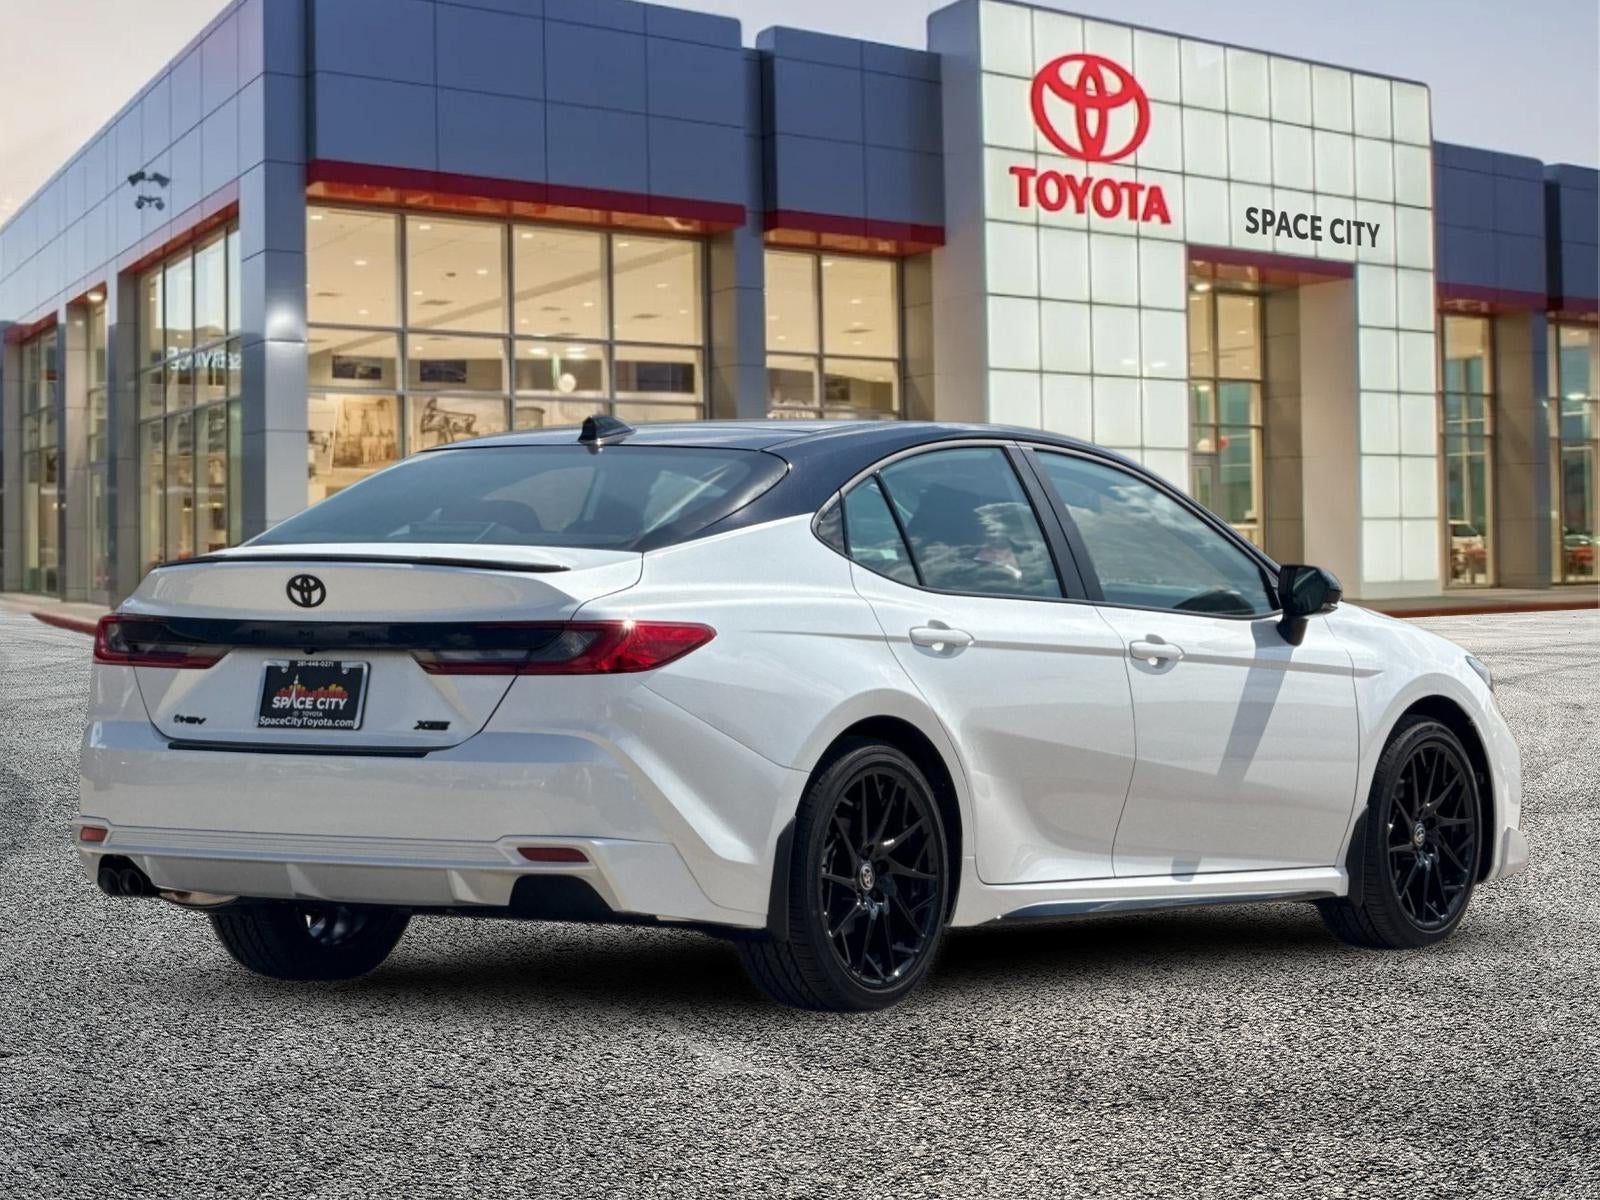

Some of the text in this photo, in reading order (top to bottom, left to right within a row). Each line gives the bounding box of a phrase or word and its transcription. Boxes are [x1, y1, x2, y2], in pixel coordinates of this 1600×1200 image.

[1009, 166, 1171, 224] TOYOTA
[1245, 206, 1380, 248] SPACE CITY
[272, 695, 348, 710] SPACE CITY
[260, 716, 354, 728] SpaceCityToyota.com
